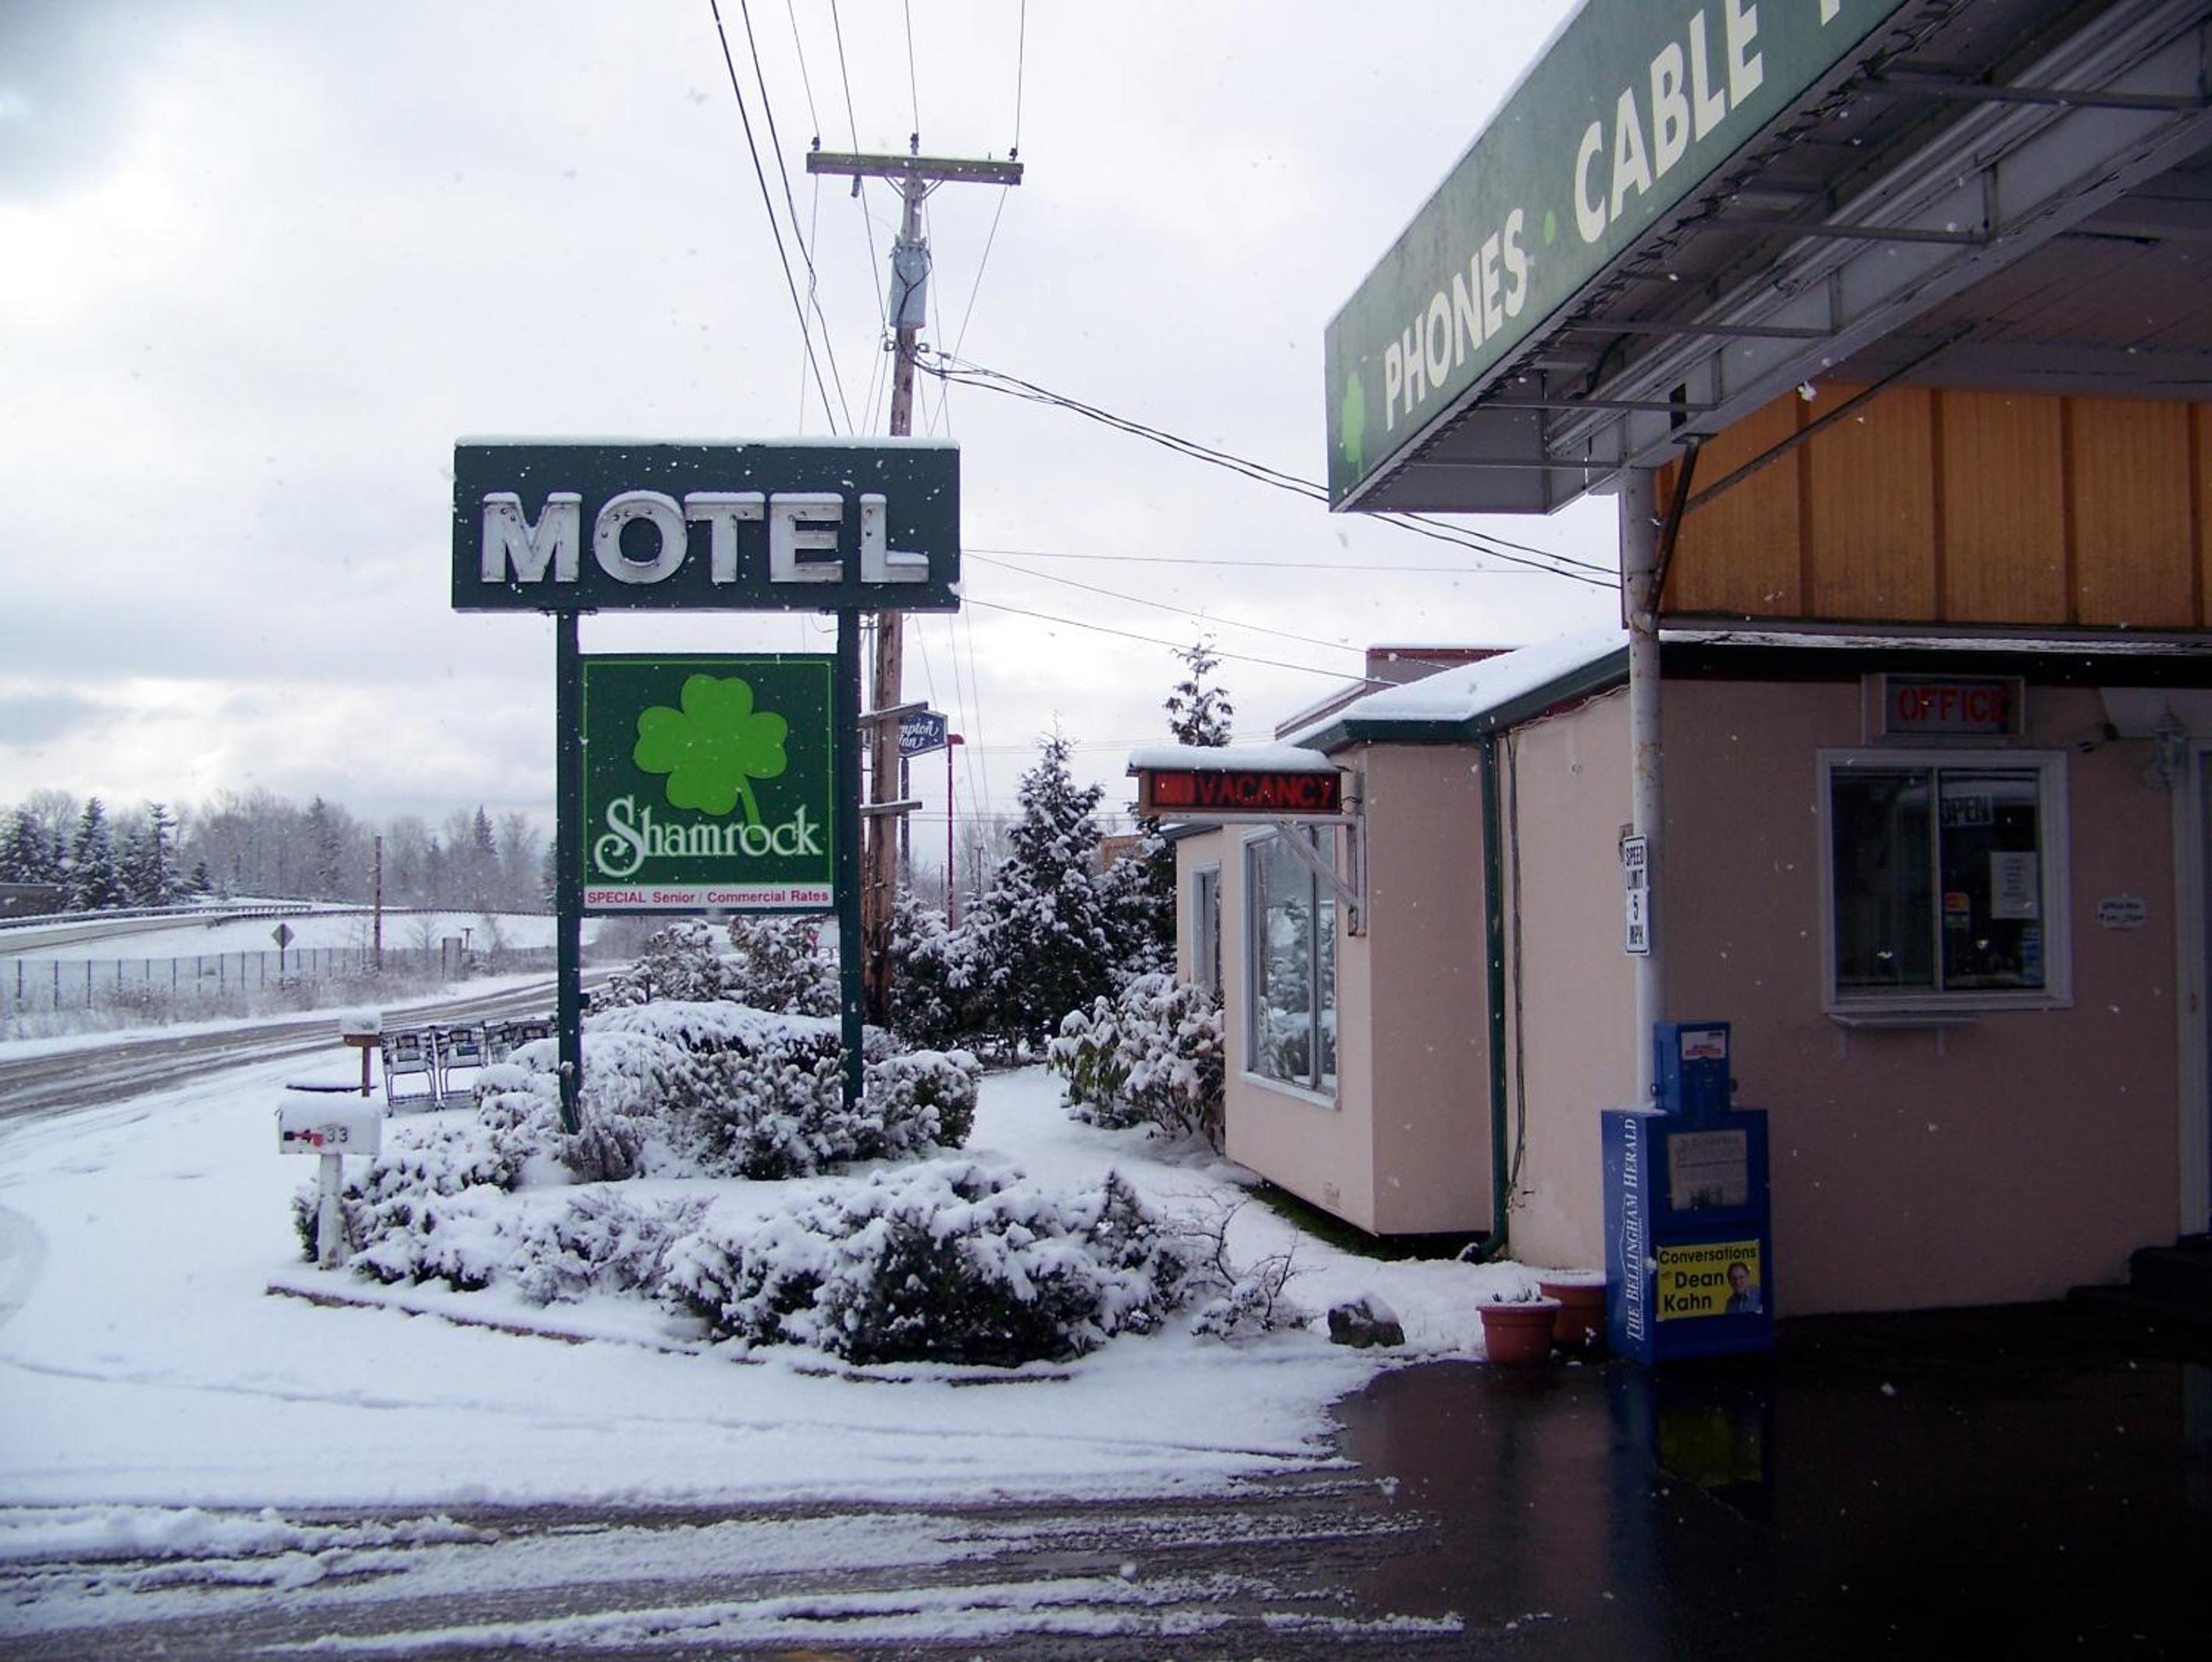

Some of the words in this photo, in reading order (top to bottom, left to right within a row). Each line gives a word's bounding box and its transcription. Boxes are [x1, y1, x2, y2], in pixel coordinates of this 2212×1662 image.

[1384, 208, 1528, 433] PHONES
[1574, 0, 1764, 244] CABLE
[481, 491, 930, 584] MOTEL
[1898, 687, 2008, 723] OFFICE
[899, 721, 939, 736] mpton
[1196, 773, 1336, 808] VACANCY
[1940, 796, 1990, 824] OPEN
[594, 795, 824, 878] Shamrock
[1625, 845, 1644, 867] SPEED
[1627, 868, 1644, 891] LIMIT
[587, 891, 646, 904] SPECIAL
[652, 890, 695, 904] Senior
[707, 889, 786, 903] Commercial
[790, 889, 829, 902] Rates
[1633, 893, 1639, 921] 5
[1624, 1118, 1638, 1187] HERALD
[1625, 1193, 1639, 1303] BELLINGHAM
[1659, 1246, 1757, 1264] Conversations
[1675, 1271, 1725, 1289] Dean
[1664, 1293, 1712, 1313] Kahn
[1626, 1305, 1644, 1341] THE
